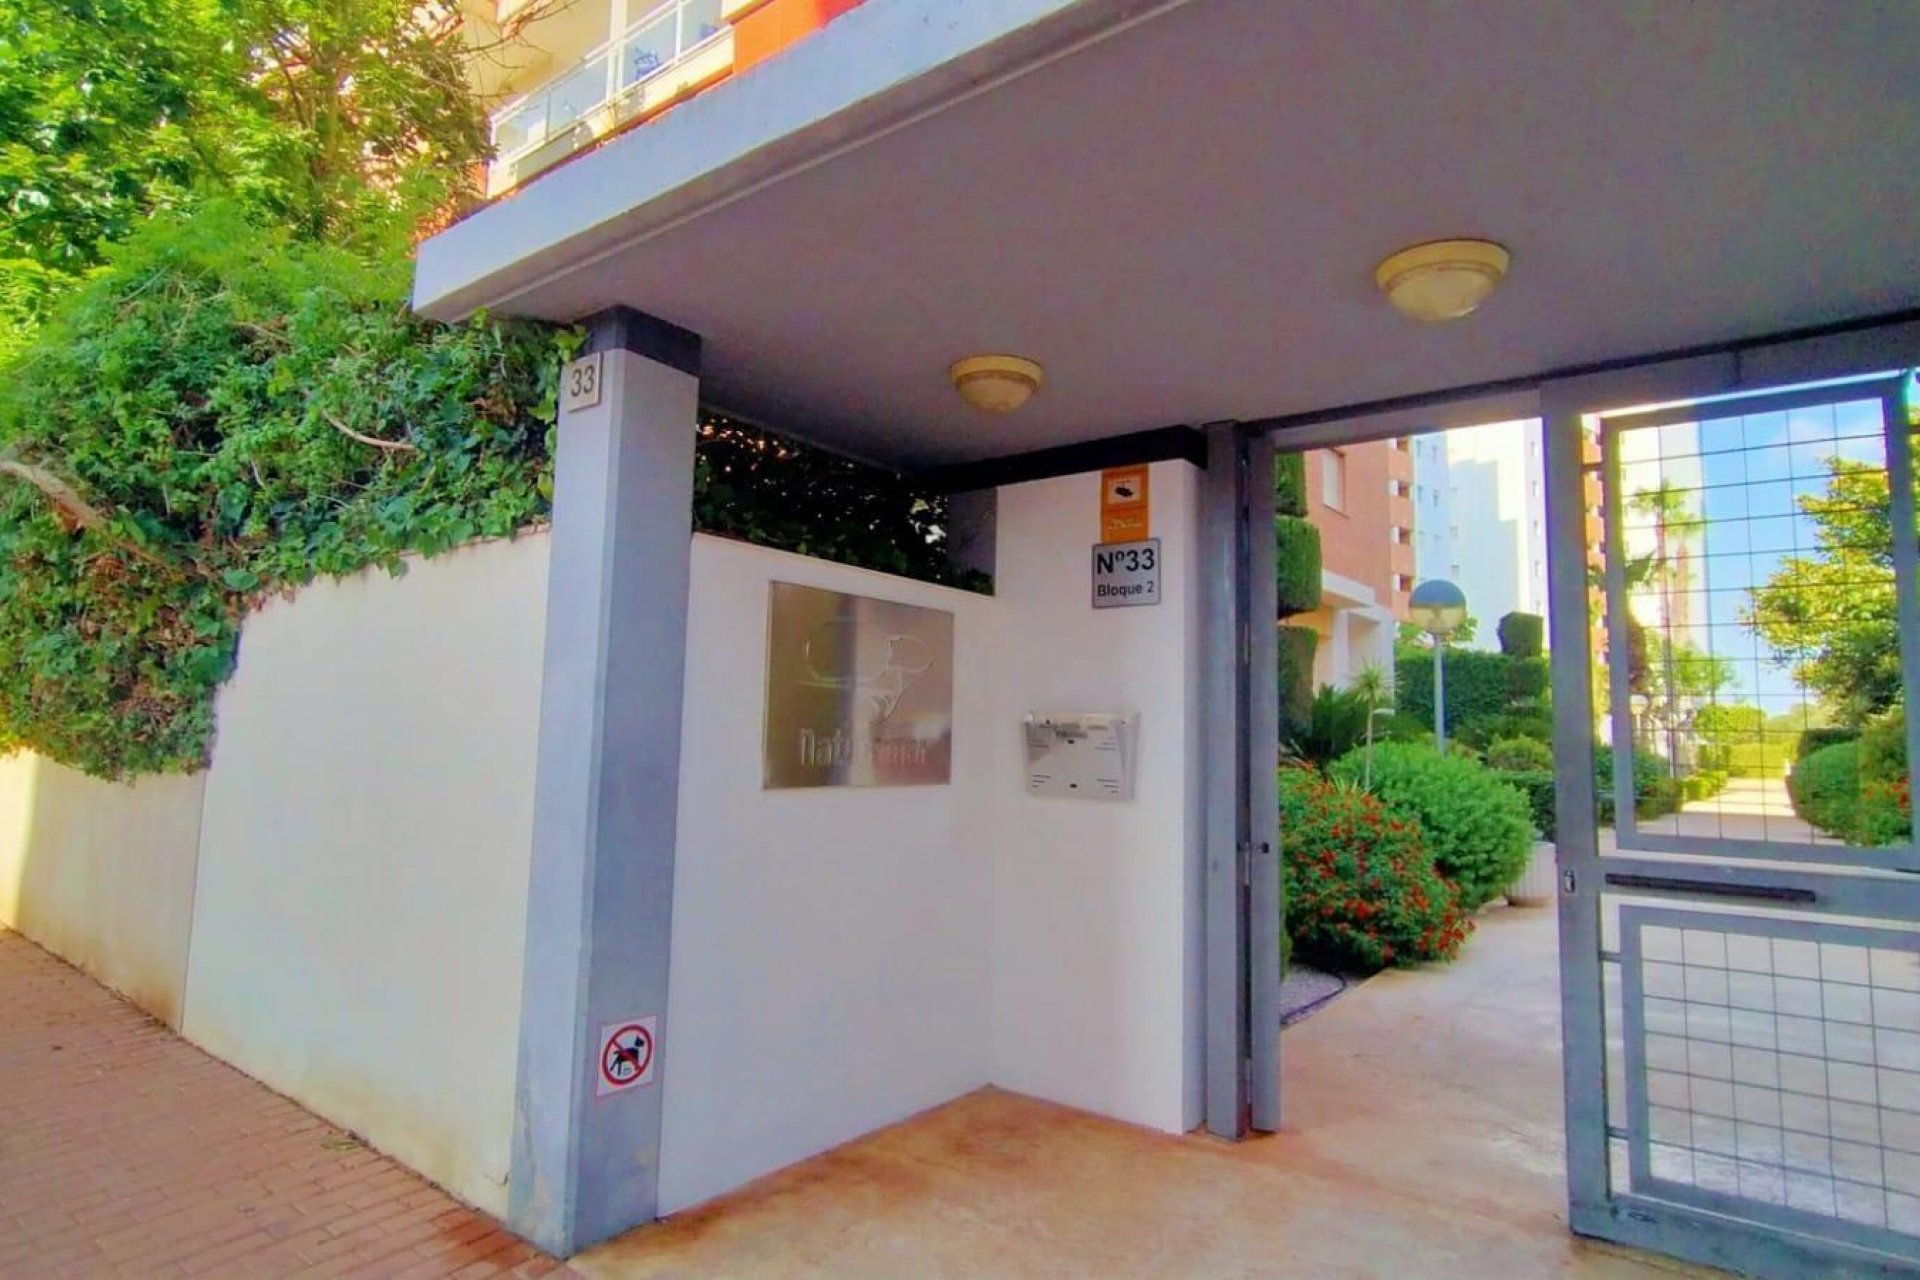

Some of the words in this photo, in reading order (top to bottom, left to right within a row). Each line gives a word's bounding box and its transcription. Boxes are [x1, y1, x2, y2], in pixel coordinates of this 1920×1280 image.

[570, 364, 596, 398] 33
[1097, 583, 1143, 598] Bloque
[1146, 581, 1154, 593] 2
